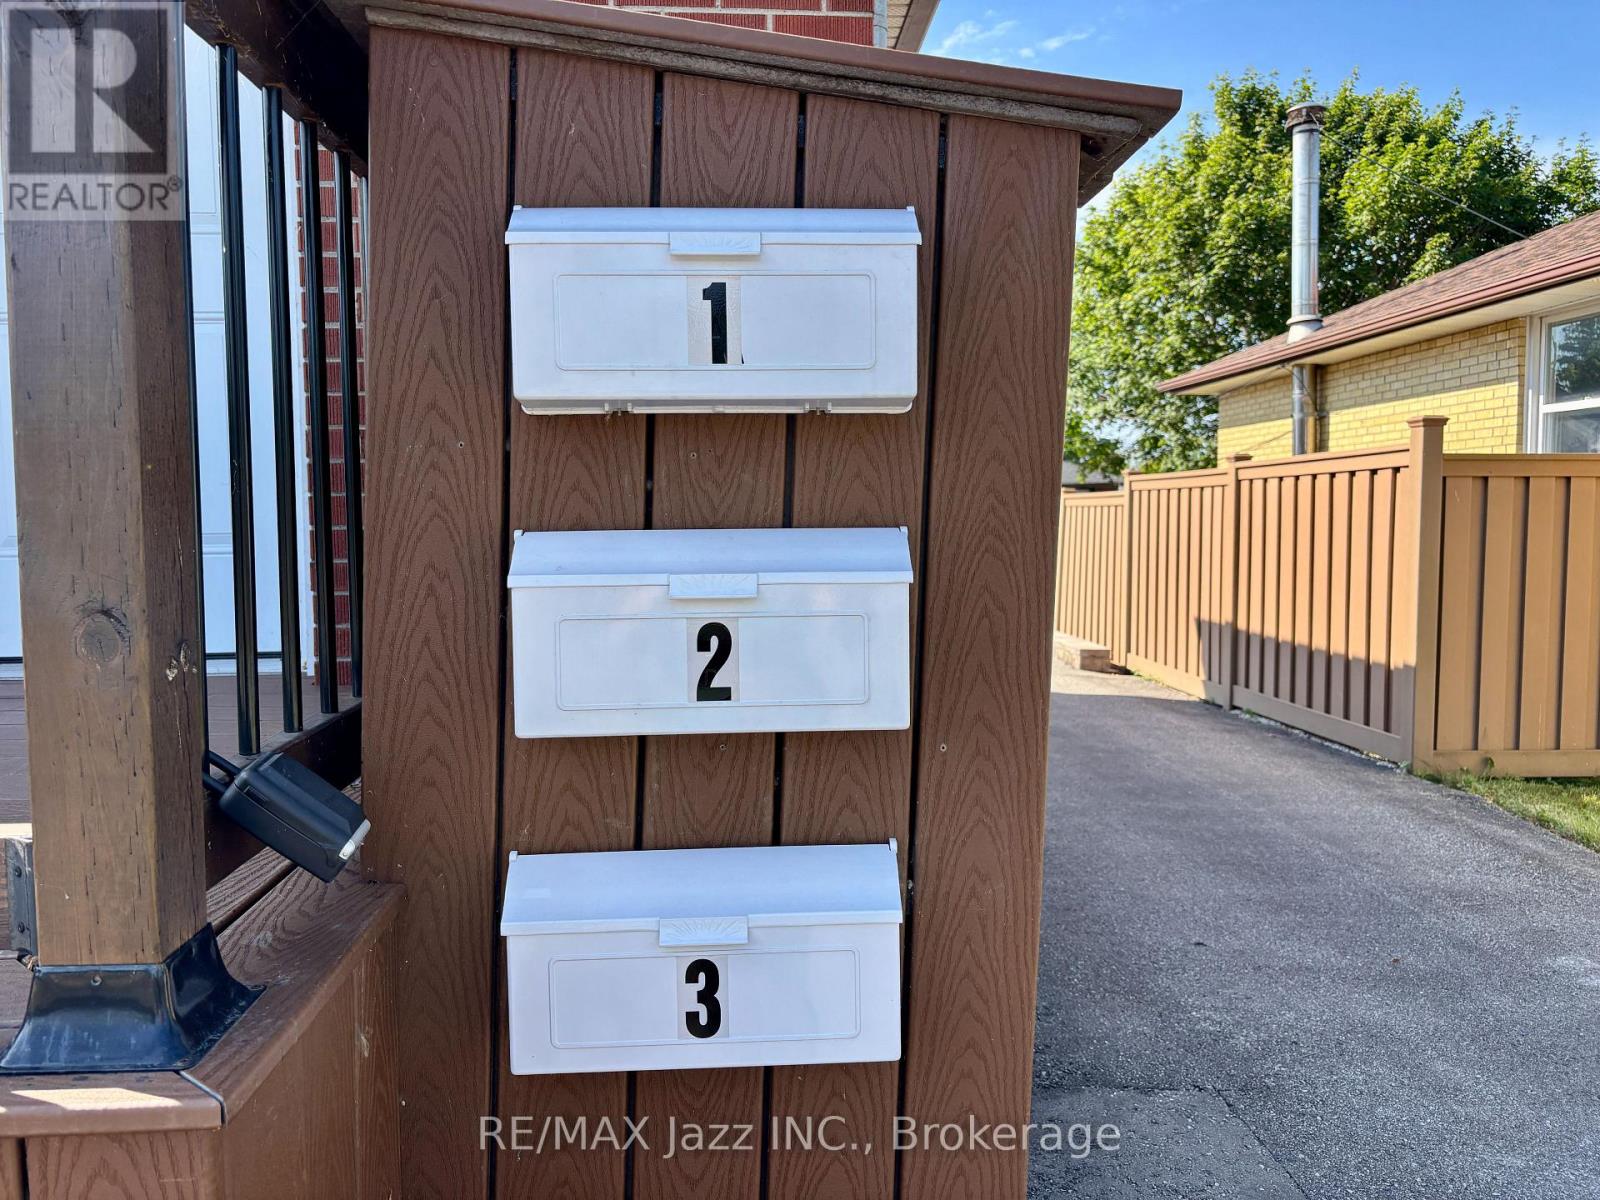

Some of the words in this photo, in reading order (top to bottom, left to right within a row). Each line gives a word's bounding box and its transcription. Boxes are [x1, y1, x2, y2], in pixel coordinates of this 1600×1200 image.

[702, 282, 728, 364] 1
[696, 622, 732, 702] 2
[685, 958, 722, 1039] 3
